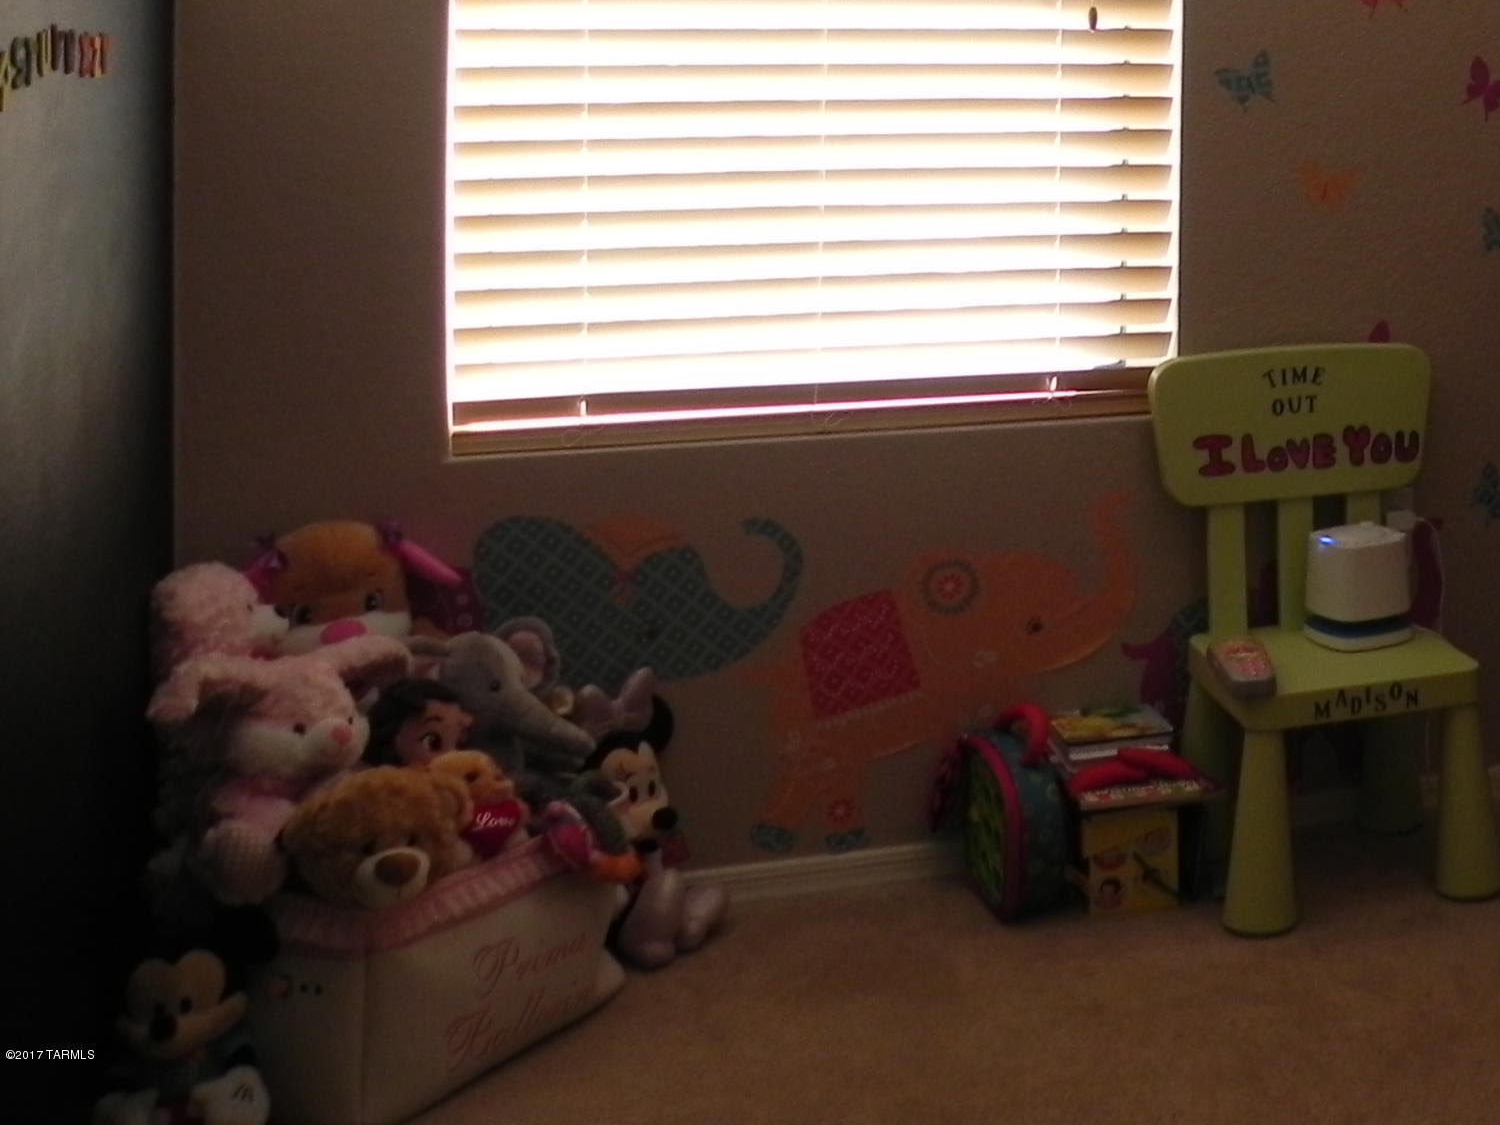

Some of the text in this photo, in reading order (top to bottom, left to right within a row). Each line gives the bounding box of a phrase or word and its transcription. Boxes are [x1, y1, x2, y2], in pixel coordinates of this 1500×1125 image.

[1262, 365, 1326, 389] TIME
[1272, 394, 1318, 416] OUT
[1192, 424, 1420, 476] I LOVE YOU
[1313, 681, 1420, 719] MADISON
